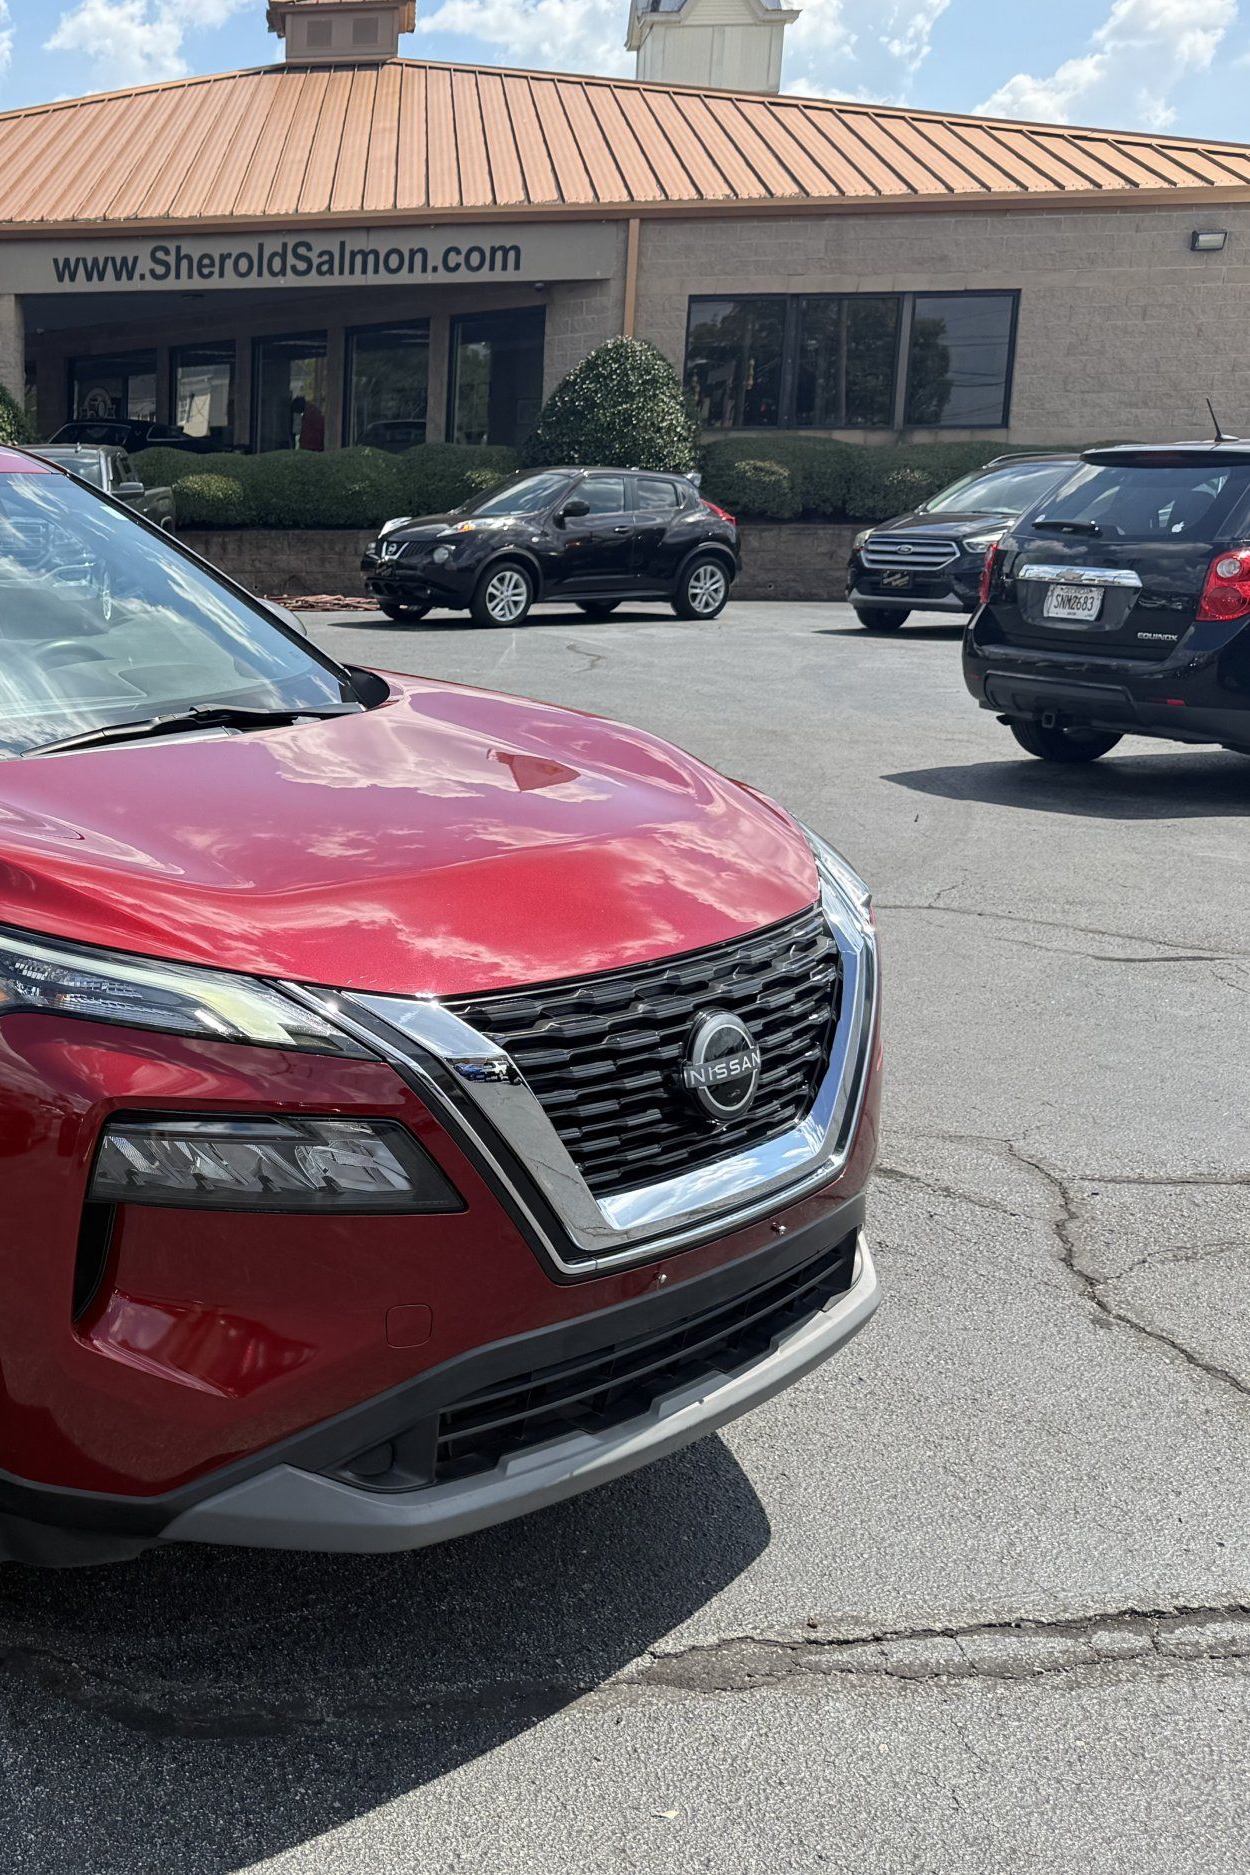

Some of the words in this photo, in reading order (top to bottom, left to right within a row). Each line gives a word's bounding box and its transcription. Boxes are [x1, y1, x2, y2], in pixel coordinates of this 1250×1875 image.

[52, 240, 521, 283] www.SheroldSalmon.com
[1137, 632, 1178, 641] EQUINOX
[690, 1050, 761, 1085] NISSAN
